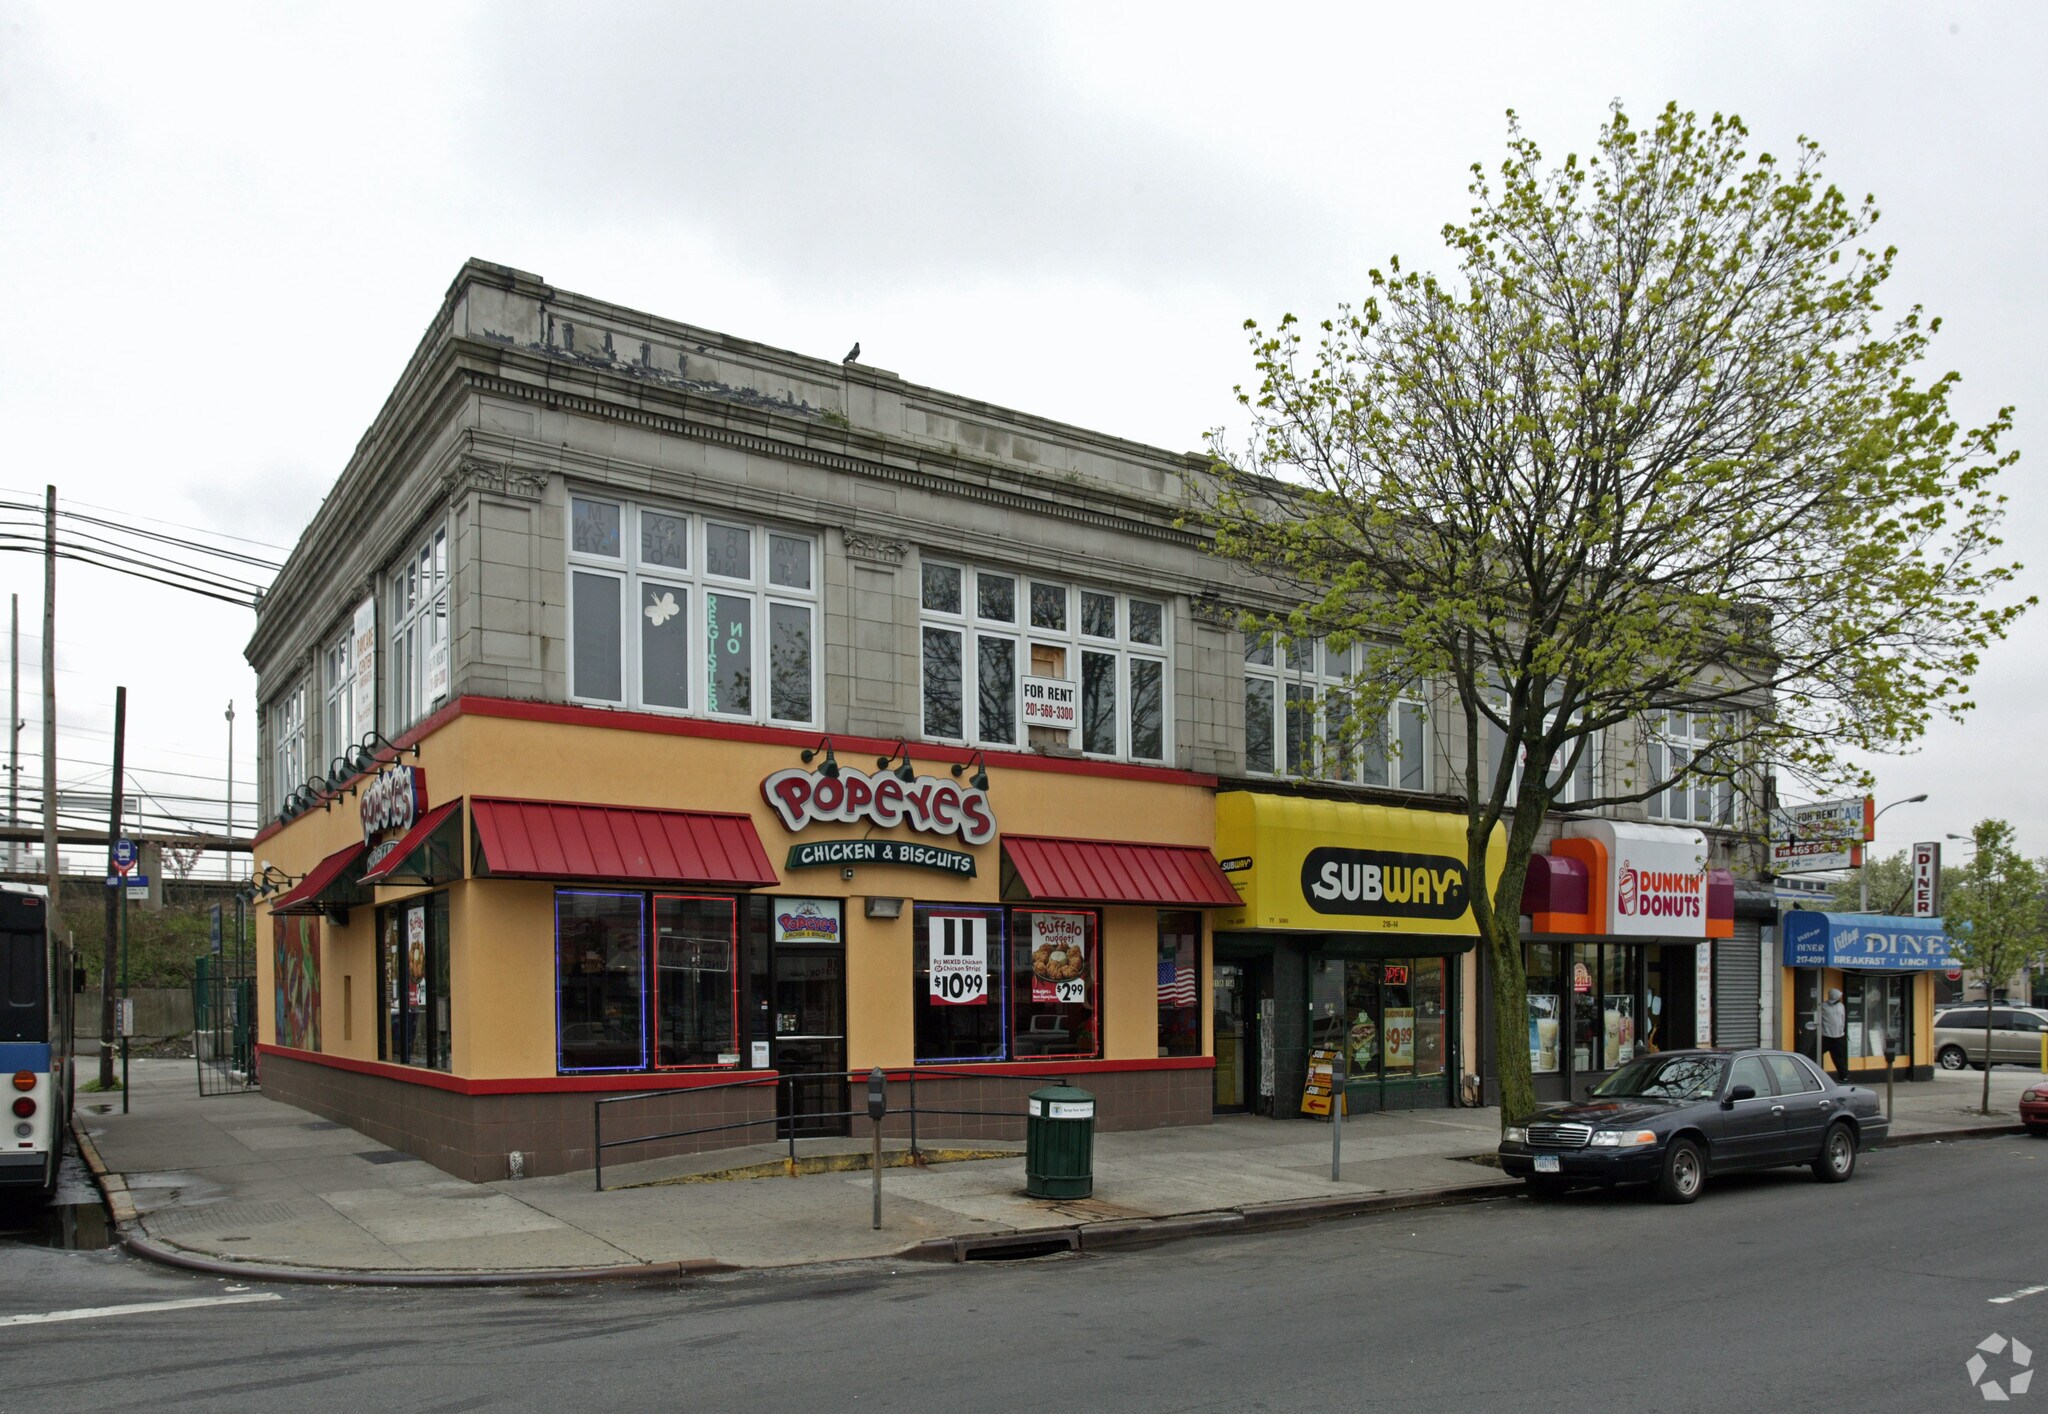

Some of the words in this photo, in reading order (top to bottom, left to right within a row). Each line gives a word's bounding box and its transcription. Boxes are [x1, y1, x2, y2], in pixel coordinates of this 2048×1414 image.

[708, 595, 719, 712] REGISTER
[1024, 684, 1044, 699] FOR
[1048, 686, 1073, 702] RENT
[1025, 702, 1073, 720] 201-568-3300
[801, 843, 875, 863] CHICKEN
[882, 845, 893, 859] &
[899, 847, 971, 871] BISCUITS
[1221, 859, 1251, 871] SUBWAY
[1311, 861, 1462, 905] SUBWAY
[1639, 870, 1704, 894] DUNKIN'
[1917, 853, 1931, 913] DINER
[1639, 896, 1700, 918] DONUTS
[1038, 920, 1082, 936] Buffalo
[1045, 934, 1075, 945] nuggets
[1797, 943, 1824, 952] DINER
[1833, 927, 1860, 953] Village
[965, 965, 981, 973] Strips
[1796, 956, 1825, 964] 217-4091
[1834, 956, 1886, 965] BREAKFAST
[1899, 957, 1928, 966] LUNCH
